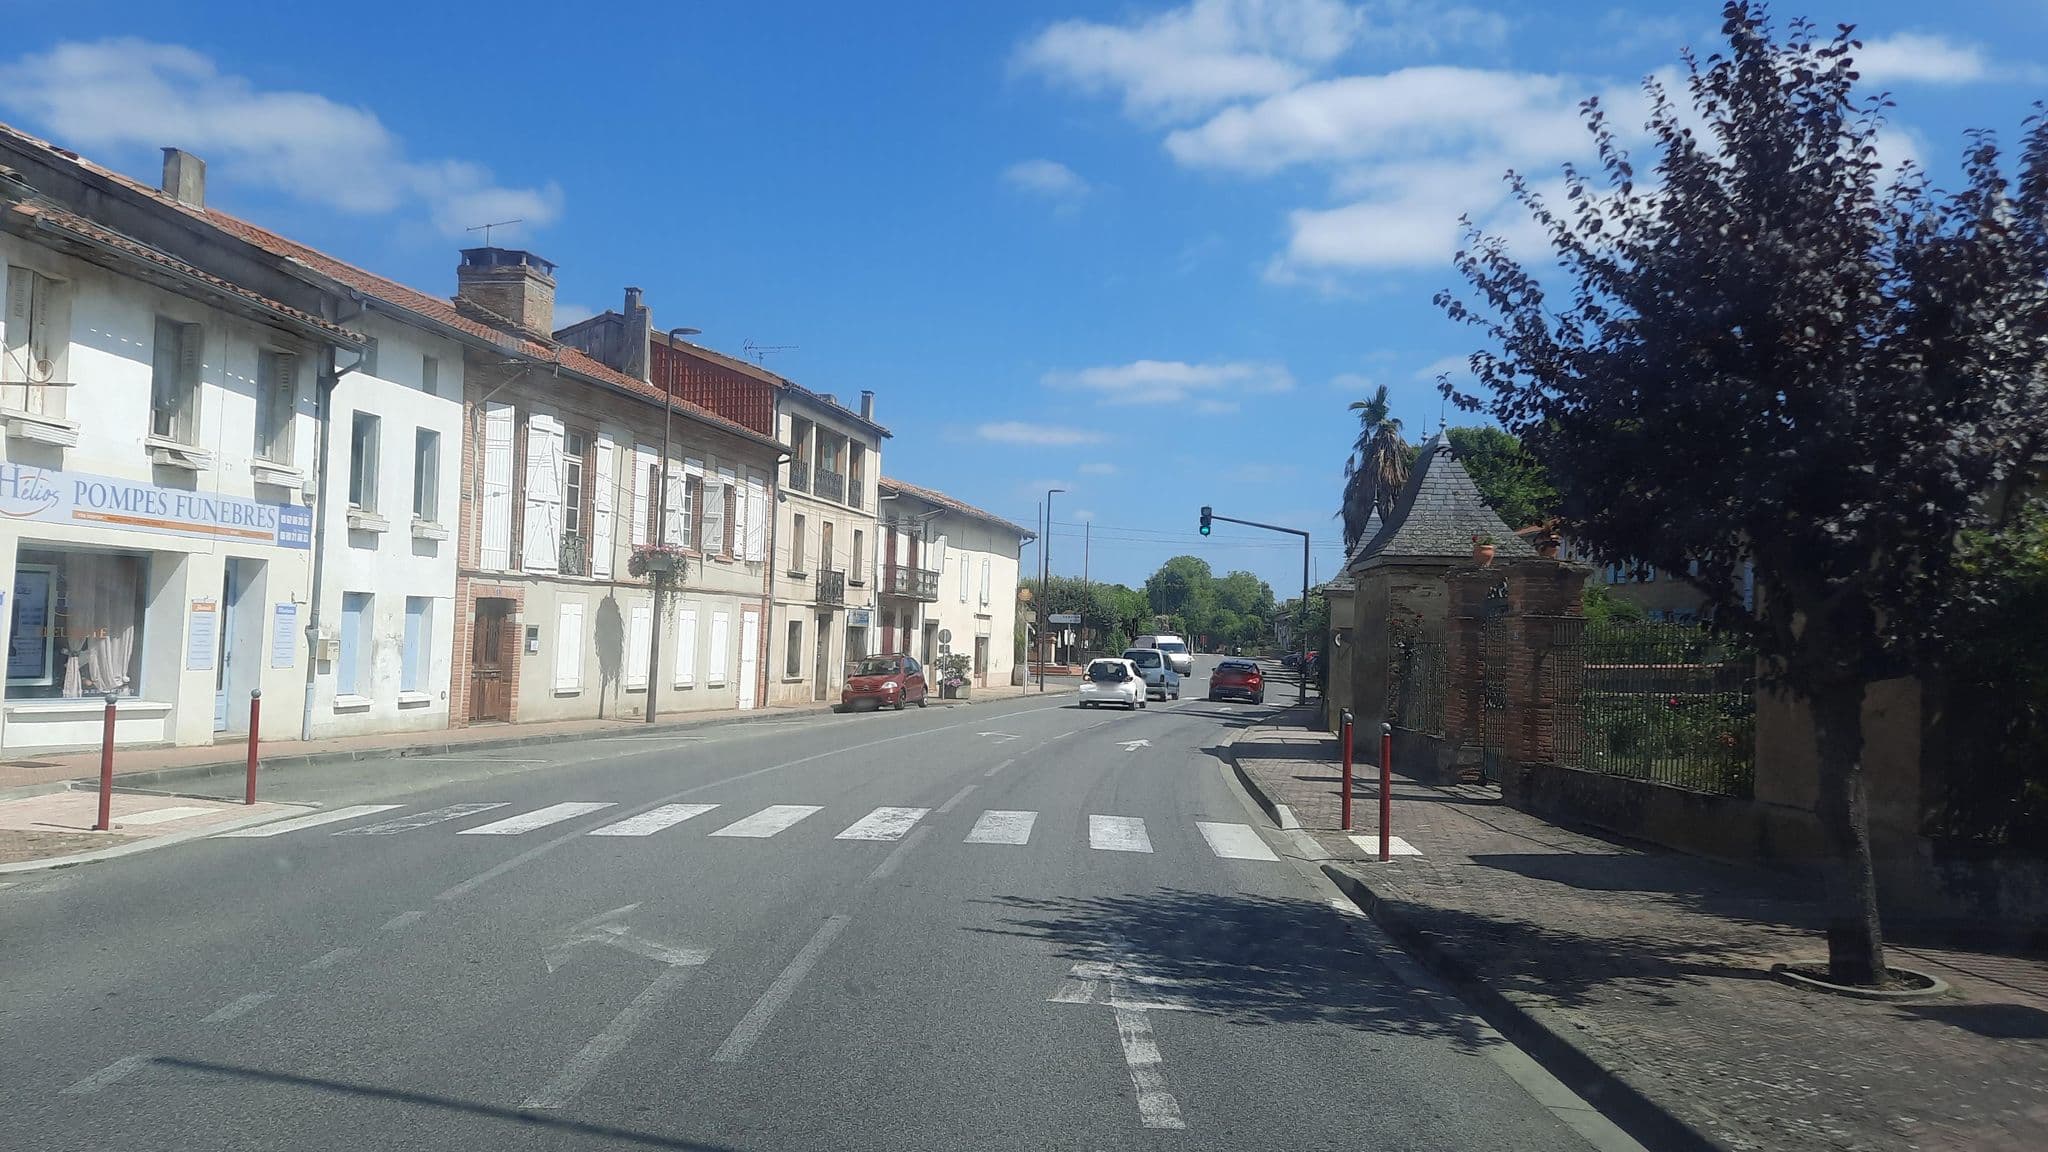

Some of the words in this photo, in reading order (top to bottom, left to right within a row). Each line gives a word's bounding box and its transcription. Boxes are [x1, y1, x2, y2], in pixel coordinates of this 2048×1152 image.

[0, 463, 59, 507] Hélios
[73, 480, 167, 515] POMPES
[175, 495, 275, 528] FUNEBRES
